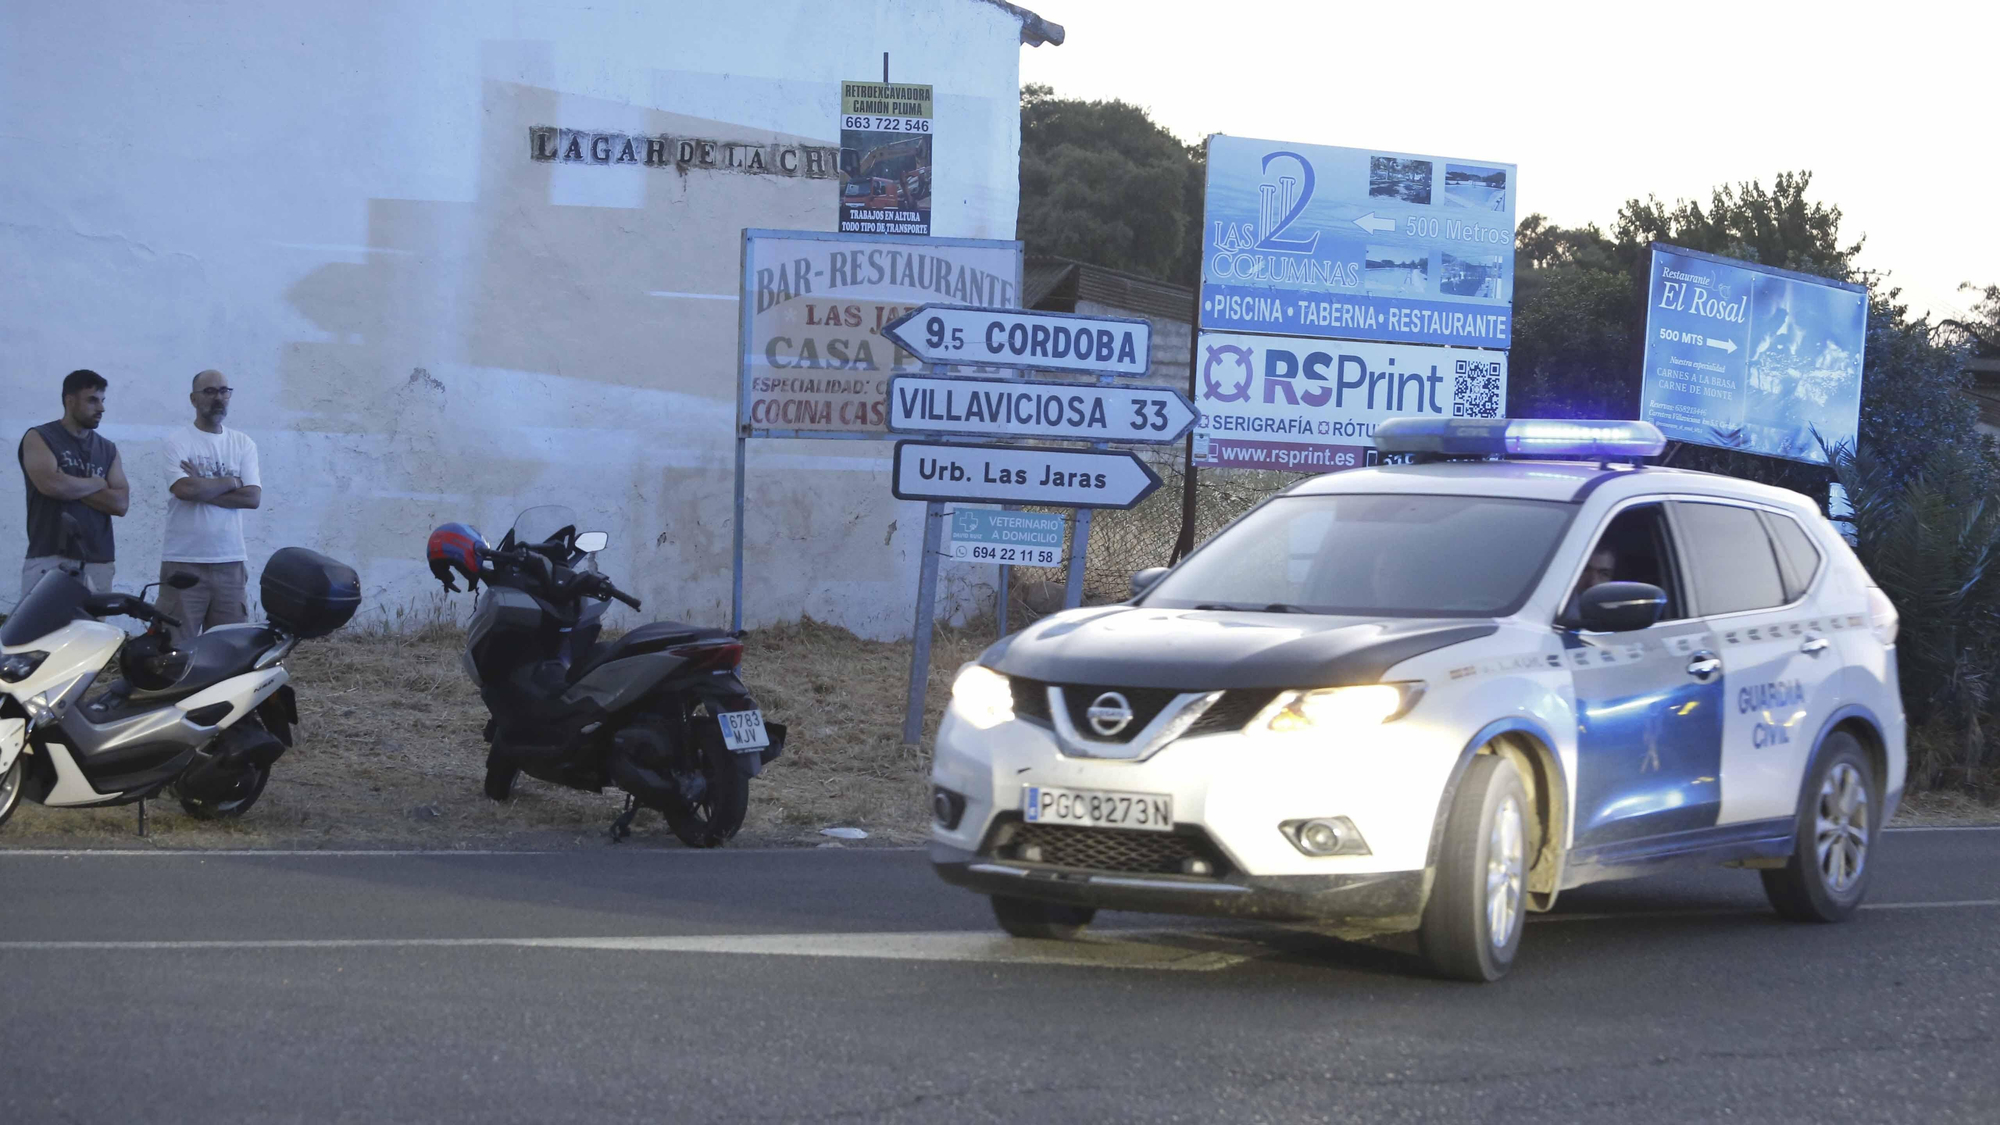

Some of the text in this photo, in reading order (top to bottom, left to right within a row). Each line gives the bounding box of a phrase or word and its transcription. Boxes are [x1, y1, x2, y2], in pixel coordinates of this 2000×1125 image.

[845, 84, 931, 101] RETROEXCAVADORA
[853, 99, 922, 115] CAMIÓN PLUMA
[845, 116, 929, 132] 663 722 546
[536, 133, 669, 164] LAGAR
[679, 140, 716, 164] DE
[728, 146, 765, 169] LA
[850, 209, 921, 222] TRABAJOS EN ALTURA
[842, 221, 928, 234] TODO TIPO DE TRANSPORTE
[1213, 220, 1254, 254] LAS
[1406, 216, 1510, 245] 500 Metros
[1211, 252, 1360, 288] COLUMNAS
[1662, 266, 1710, 286] Restaurante
[1658, 281, 1748, 324] El Rosal
[805, 304, 917, 335] LAS JA
[1213, 295, 1507, 339] PISCINA TABERNA RESTAURANTE
[925, 316, 964, 352] 9,5
[985, 320, 1137, 365] CORDOBA
[1660, 328, 1703, 346] 500 MTS
[765, 336, 880, 372] CASA
[752, 377, 870, 395] ESPECIALIDAD:
[1263, 348, 1444, 414] RSPrint
[1656, 367, 1736, 390] CARNES A LA BRASA
[1658, 379, 1733, 401] CARNE DE MONTE
[751, 399, 888, 426] COCINA CAS
[899, 386, 1107, 429] VILLAVICIOSA
[1130, 399, 1168, 431] 33
[1212, 414, 1380, 438] SERIGRAFÍA RÓTU
[1221, 446, 1356, 467] www.rsprint.es
[918, 457, 1107, 489] Urb. Las Jaras
[989, 515, 1059, 531] VETERINARIO
[991, 530, 1058, 543] A DOMICILIO
[973, 546, 1053, 563] 694 22 11 58
[1738, 679, 1805, 714] GUARDIA
[730, 711, 761, 729] 6783
[733, 729, 757, 744] MJV
[1752, 722, 1791, 749] CIVIL
